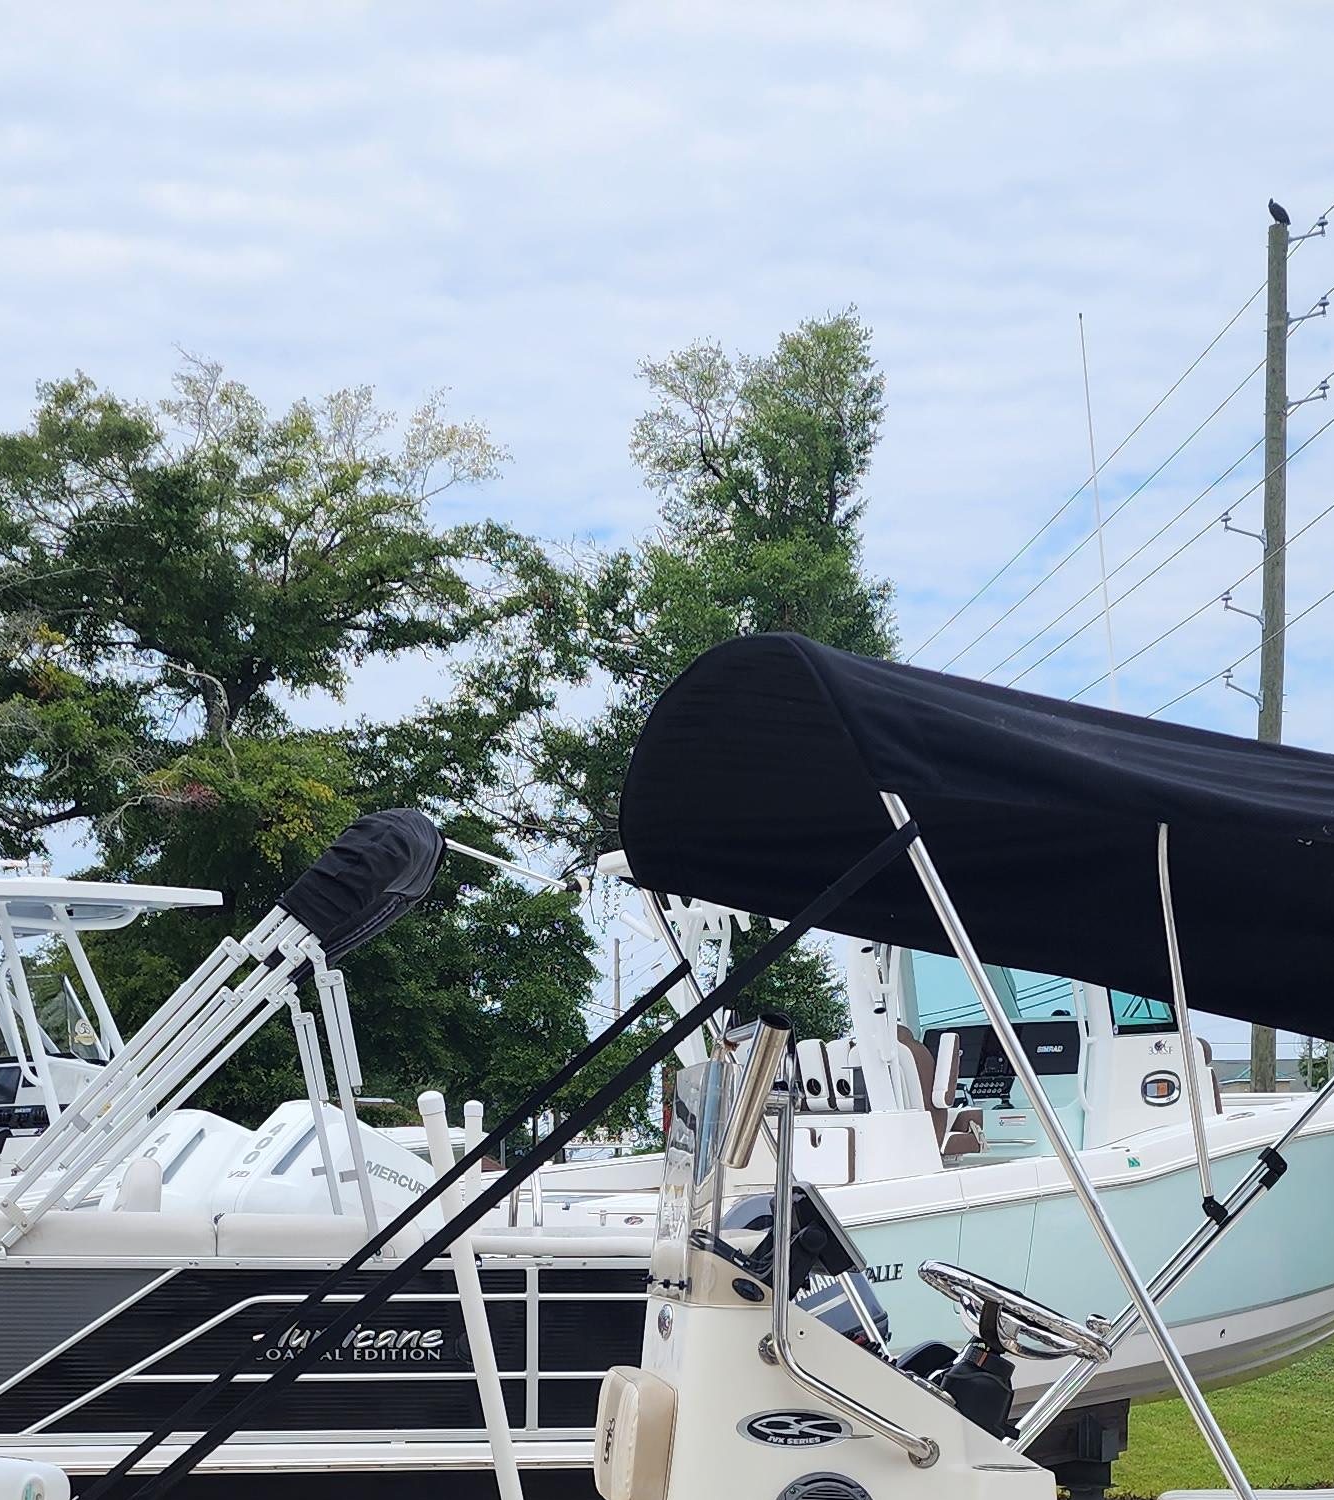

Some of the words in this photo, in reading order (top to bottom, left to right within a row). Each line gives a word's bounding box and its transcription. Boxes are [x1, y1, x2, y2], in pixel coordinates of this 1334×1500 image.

[366, 1161, 429, 1196] MERCUR
[353, 1348, 441, 1361] EDITION
[786, 1436, 821, 1445] SERIES
